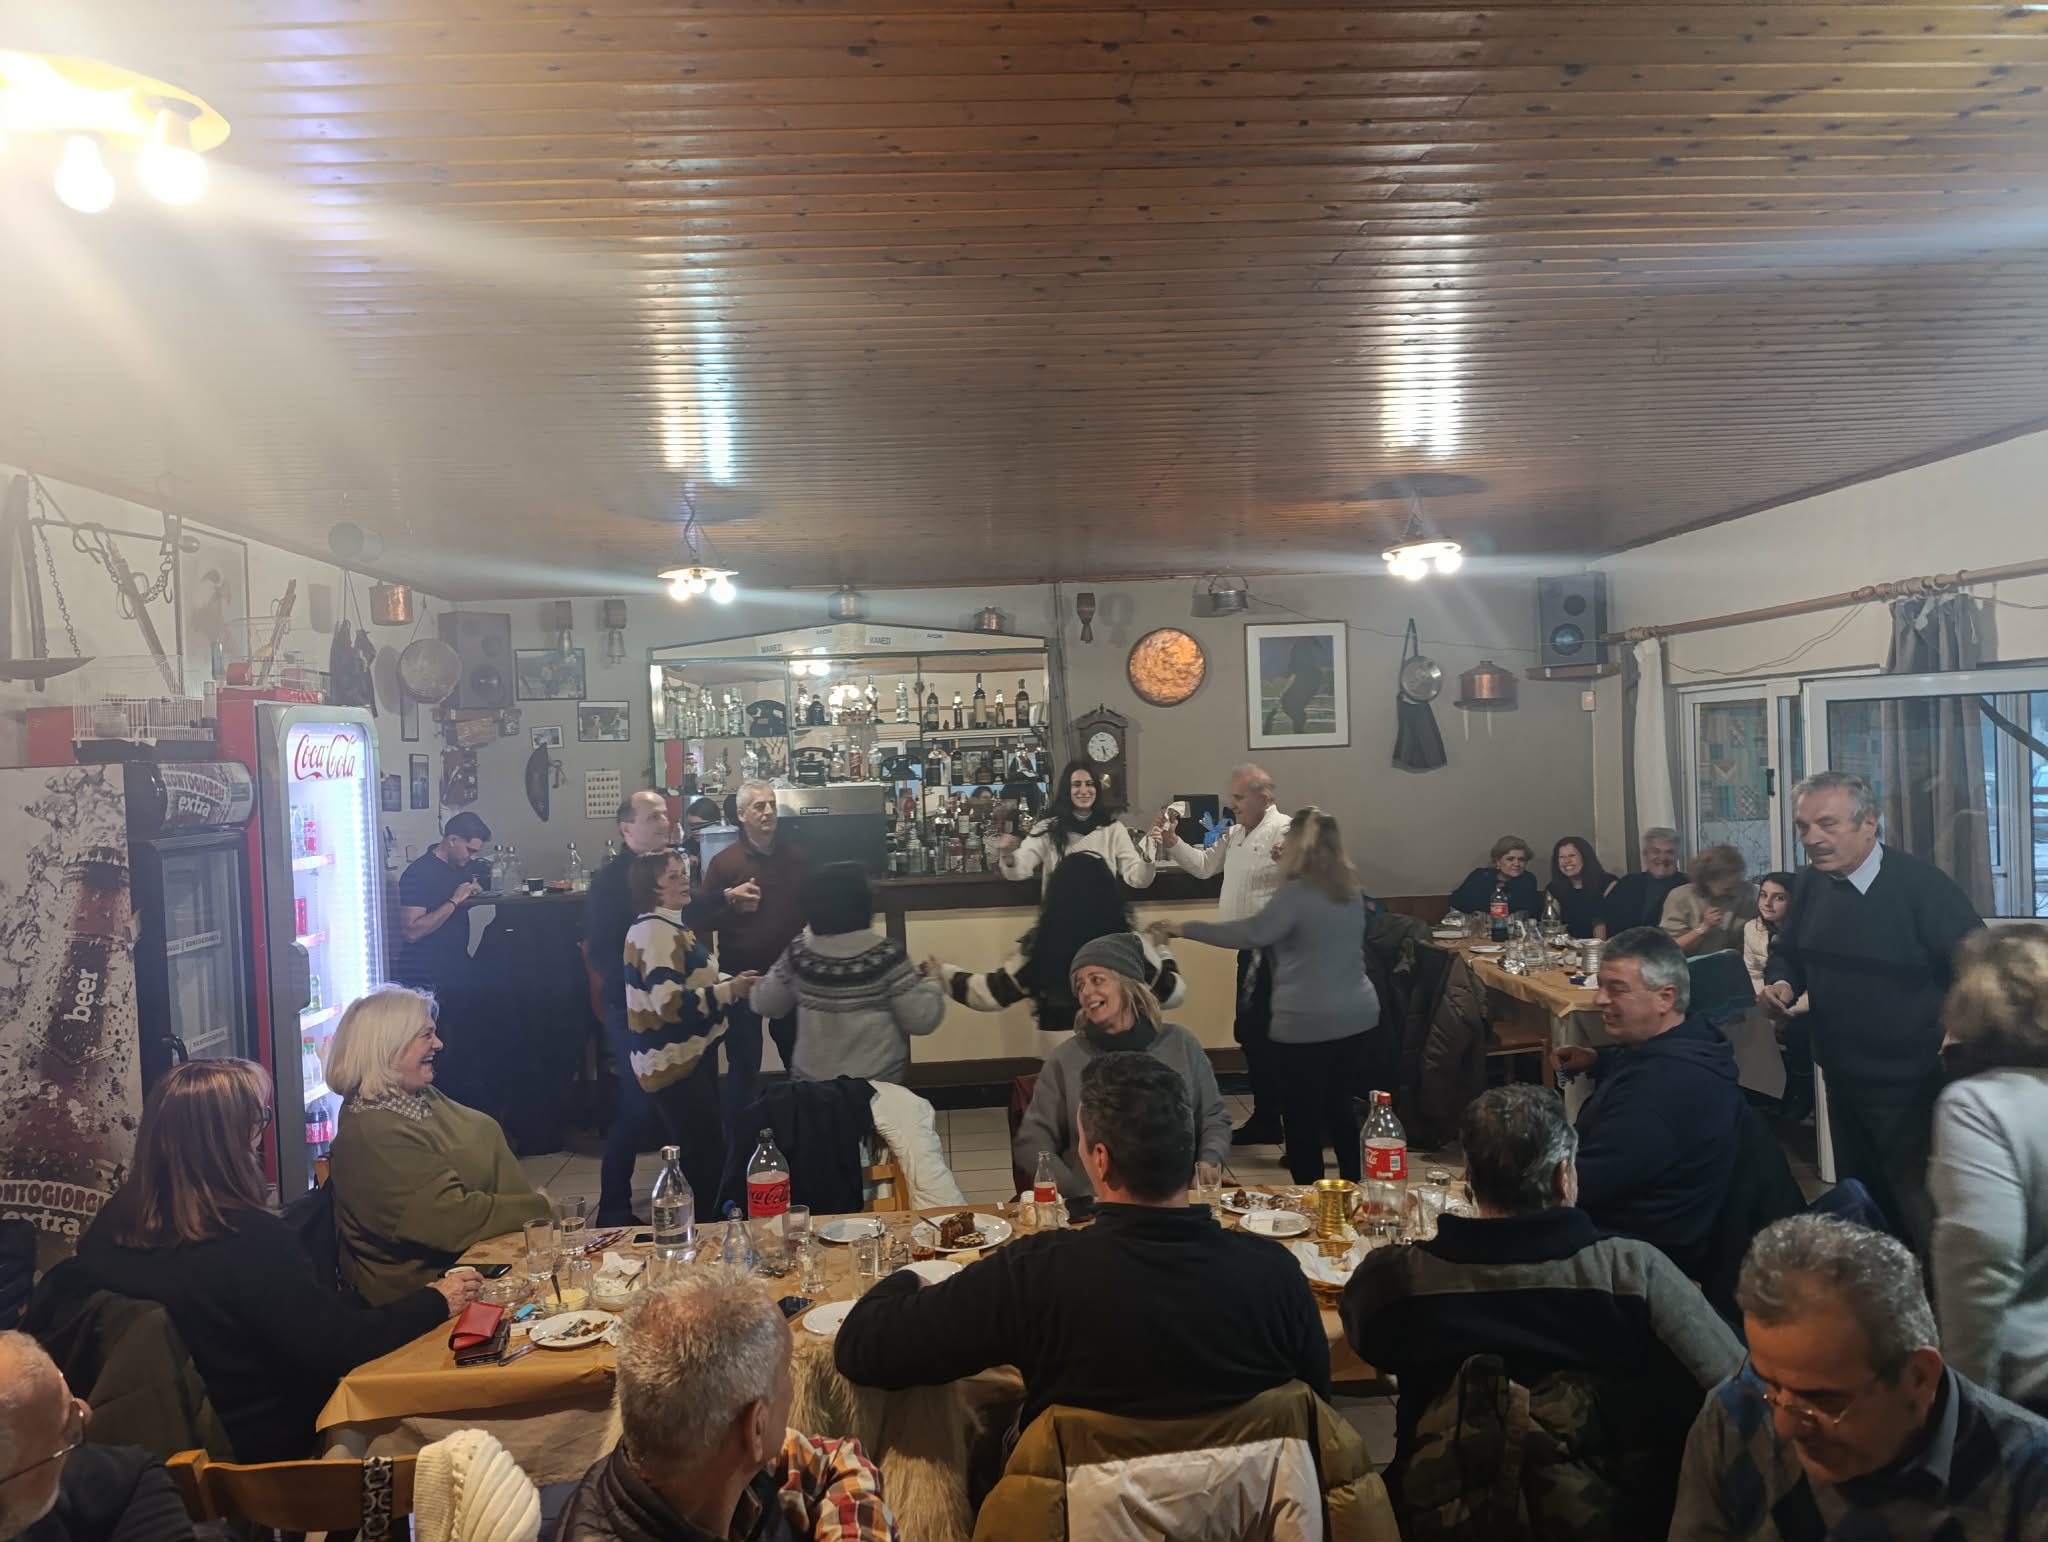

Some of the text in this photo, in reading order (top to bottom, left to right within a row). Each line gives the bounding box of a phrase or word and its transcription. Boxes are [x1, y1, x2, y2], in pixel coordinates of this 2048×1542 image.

[294, 733, 358, 781] Coca-Cola
[178, 796, 211, 817] extra
[64, 969, 98, 1023] beer
